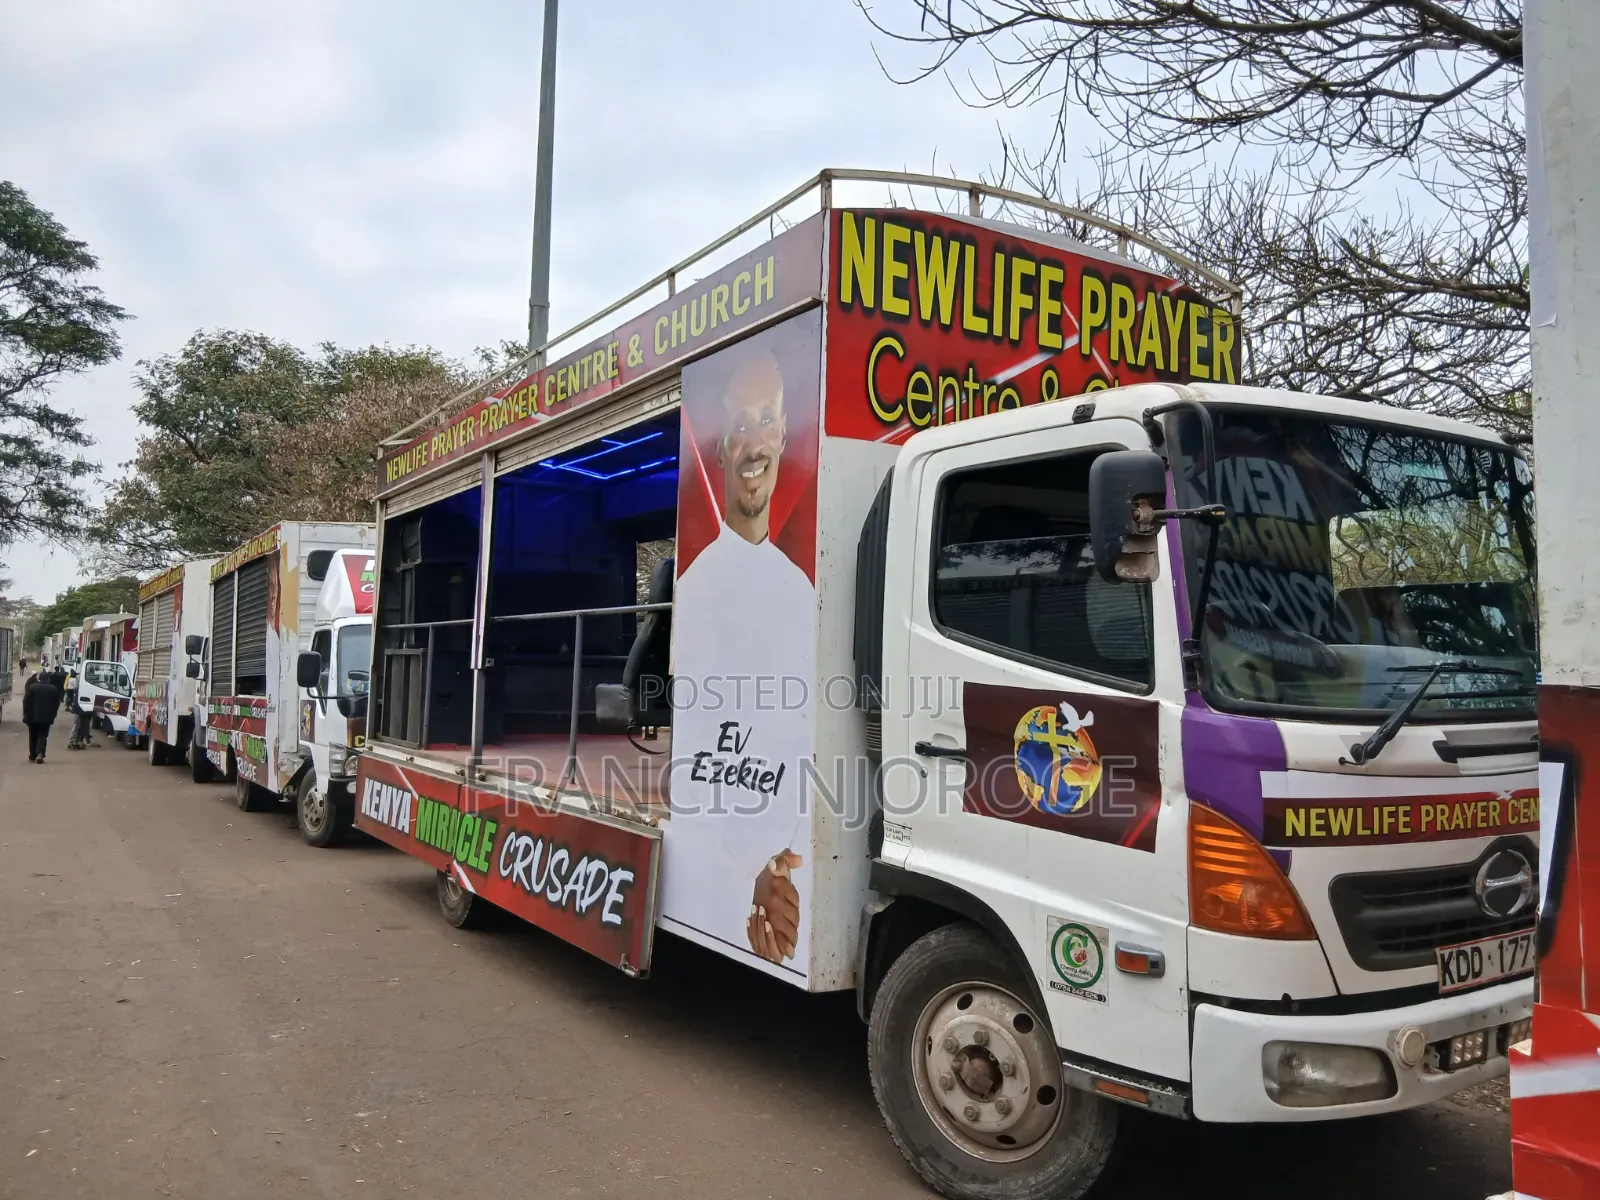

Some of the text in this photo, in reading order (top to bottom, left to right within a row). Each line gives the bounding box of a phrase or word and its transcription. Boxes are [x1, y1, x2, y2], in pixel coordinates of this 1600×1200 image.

[840, 211, 1235, 384] NEWLIFE PRAYER
[386, 256, 775, 483] NEWLIFE PRAYER PRAYER CENTRE & CHURCH
[691, 751, 786, 796] Ezekiel
[1285, 805, 1411, 837] NEWLIFE
[1421, 801, 1500, 831] PRAYER
[361, 777, 634, 925] KENYA MIRACLE CRUSADE
[1440, 934, 1535, 987] KDD 177
